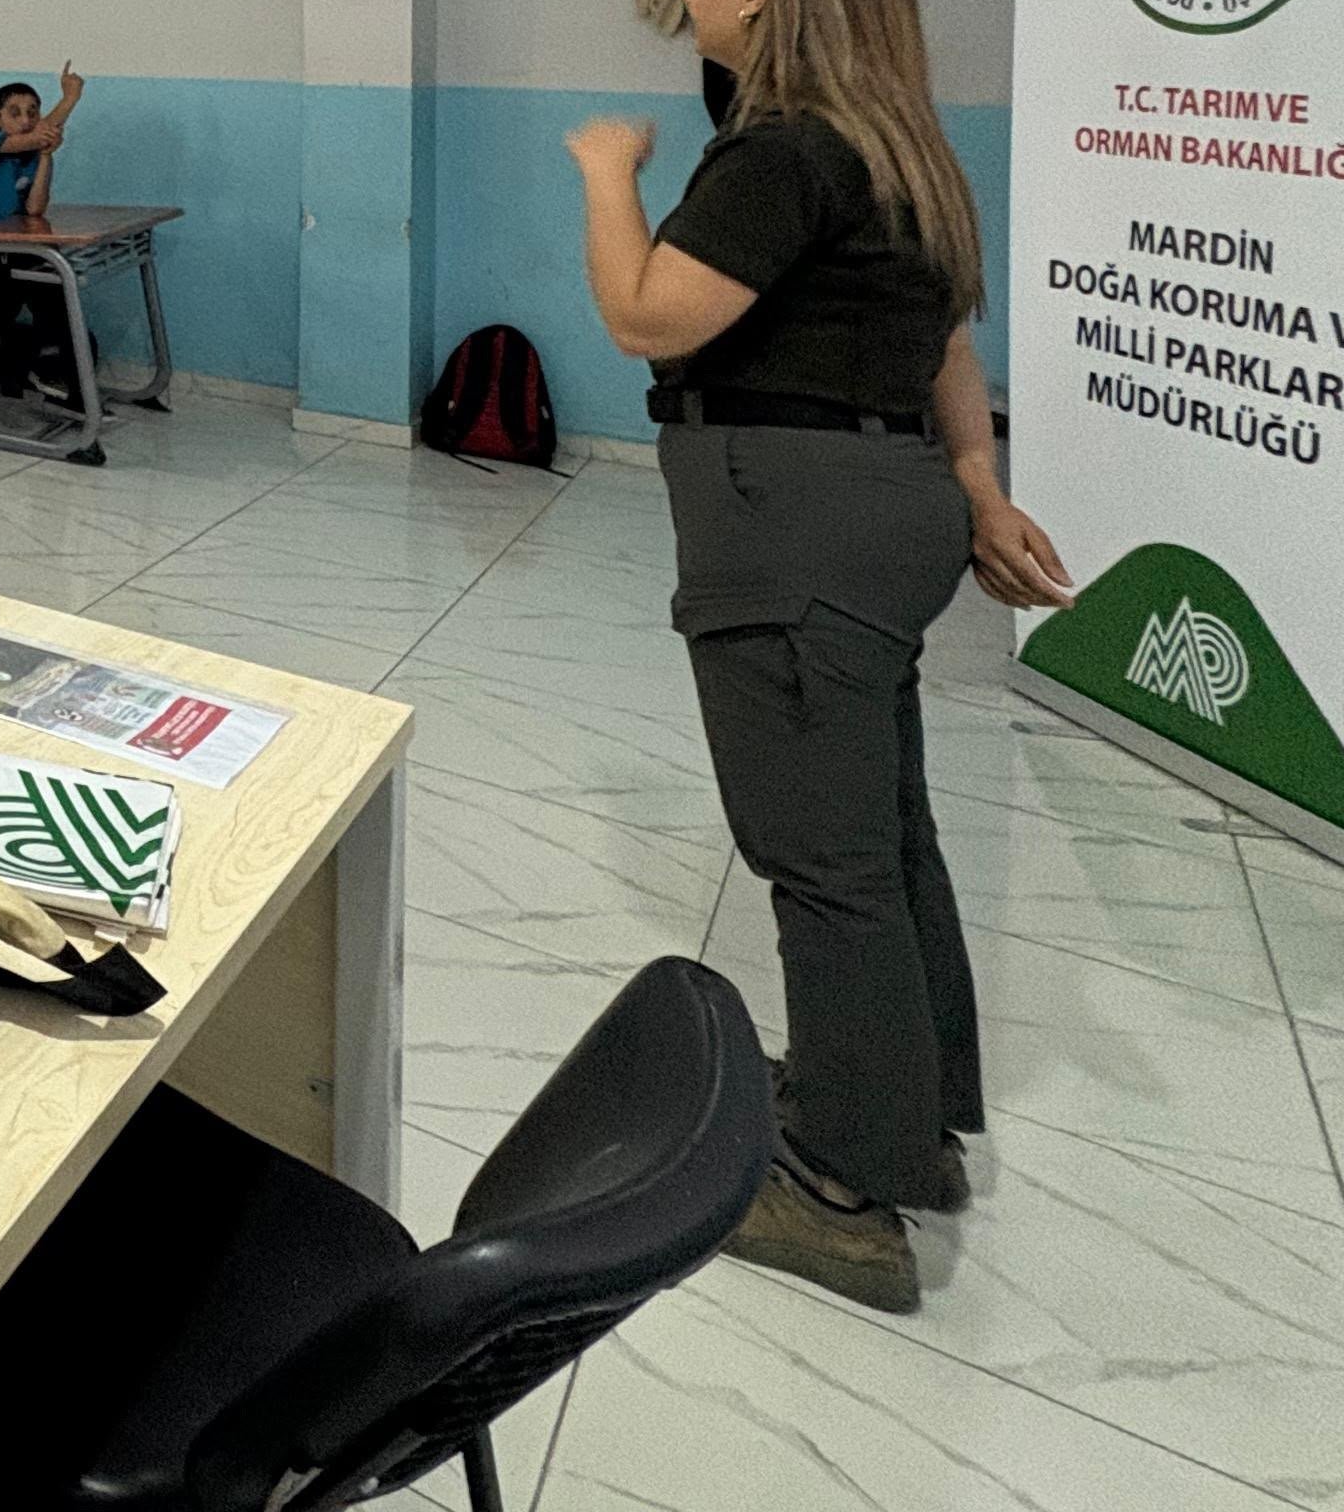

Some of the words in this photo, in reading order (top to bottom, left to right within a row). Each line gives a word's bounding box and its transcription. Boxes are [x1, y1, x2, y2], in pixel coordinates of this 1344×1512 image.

[1115, 84, 1158, 113] T.C.
[1163, 87, 1260, 121] TARIM
[1265, 92, 1310, 124] VE
[1075, 127, 1173, 162] ORMAN
[1128, 220, 1274, 275] MARDİN
[1049, 259, 1141, 307] DOĞA
[1150, 278, 1318, 344] KORUMA
[1076, 314, 1155, 365] MİLLİ
[1165, 337, 1344, 412] PARKLAR
[1087, 371, 1321, 465] MÜDÜRLÜĞÜ
